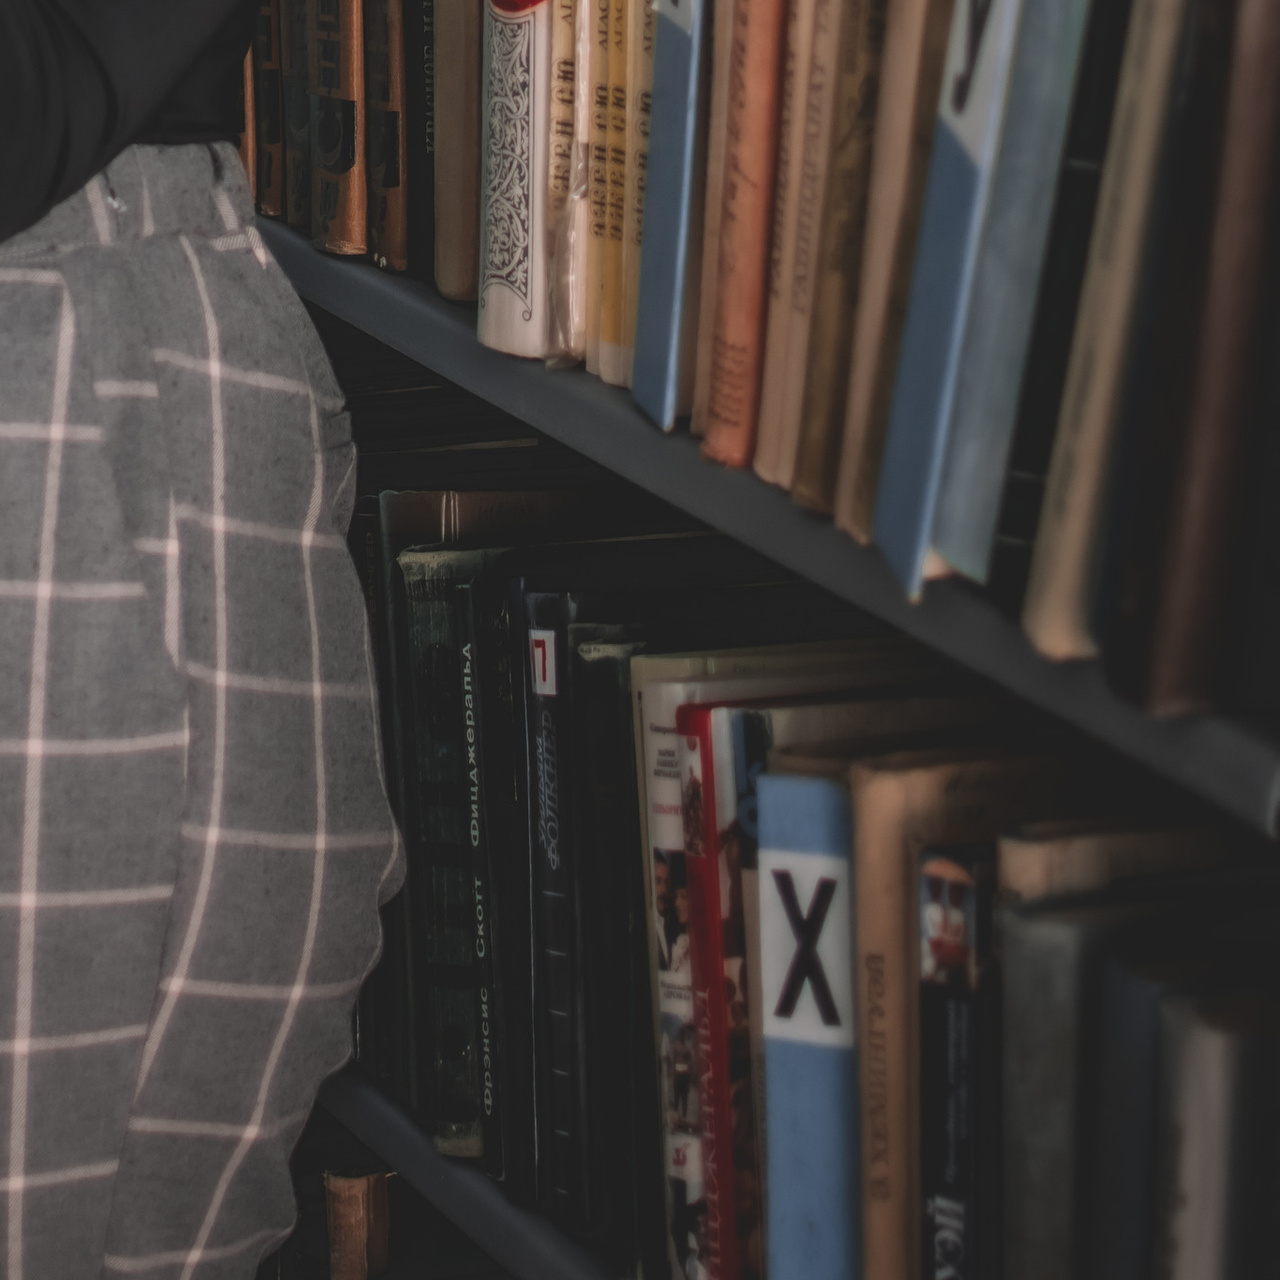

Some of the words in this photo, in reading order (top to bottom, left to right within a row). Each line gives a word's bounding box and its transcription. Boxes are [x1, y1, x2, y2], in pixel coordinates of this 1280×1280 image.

[541, 710, 560, 871] ФОЛКНЕР
[474, 877, 486, 958] Скотт
[772, 870, 841, 1026] Х
[480, 986, 493, 1116] Фрэнсис
